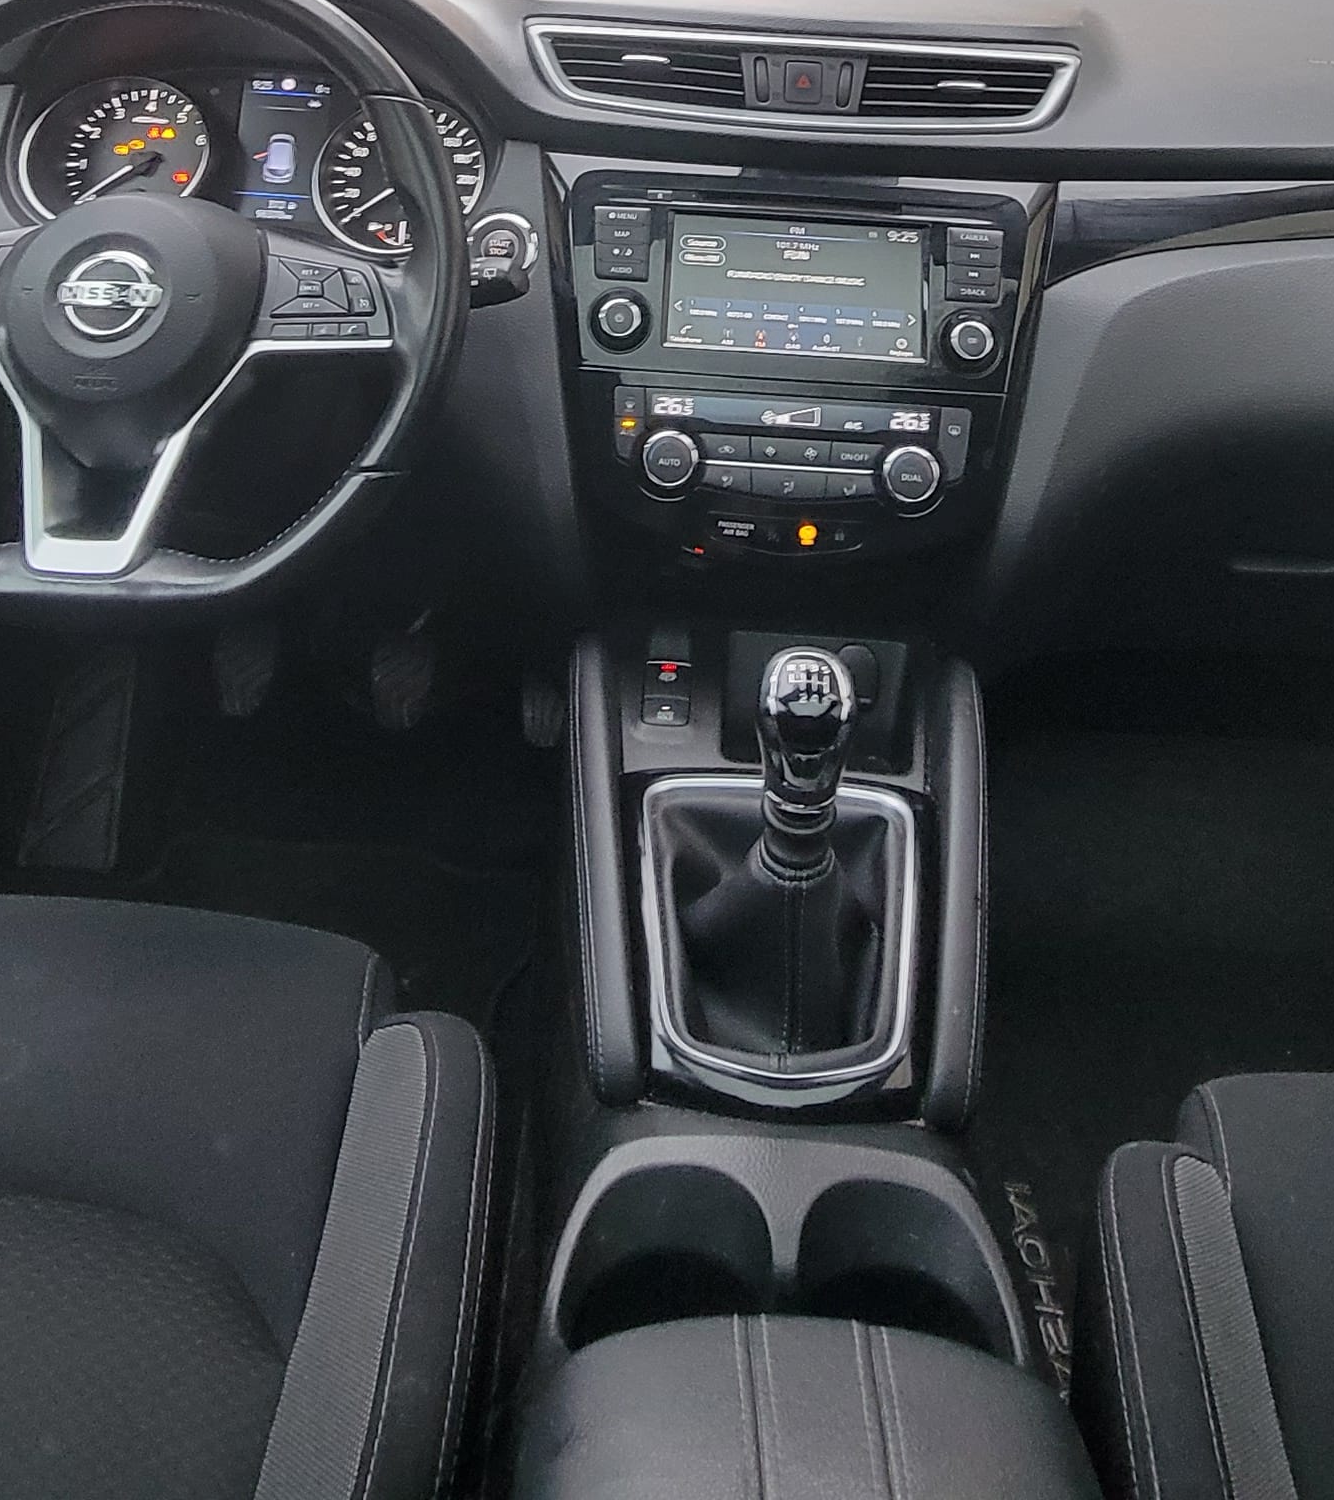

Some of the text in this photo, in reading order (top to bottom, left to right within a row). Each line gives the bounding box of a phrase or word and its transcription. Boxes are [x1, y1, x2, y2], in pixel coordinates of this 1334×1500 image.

[145, 101, 158, 112] 4
[112, 108, 126, 120] 3
[175, 112, 188, 124] 5
[88, 127, 102, 139] 2
[195, 134, 207, 146] 6
[616, 212, 637, 220] MENU
[886, 230, 919, 243] 9:25
[488, 239, 511, 247] START
[488, 248, 508, 256] STOP
[610, 266, 632, 274] AUDIO
[968, 288, 986, 297] BACK
[657, 457, 681, 467] AUTO
[900, 473, 923, 482] DUAL
